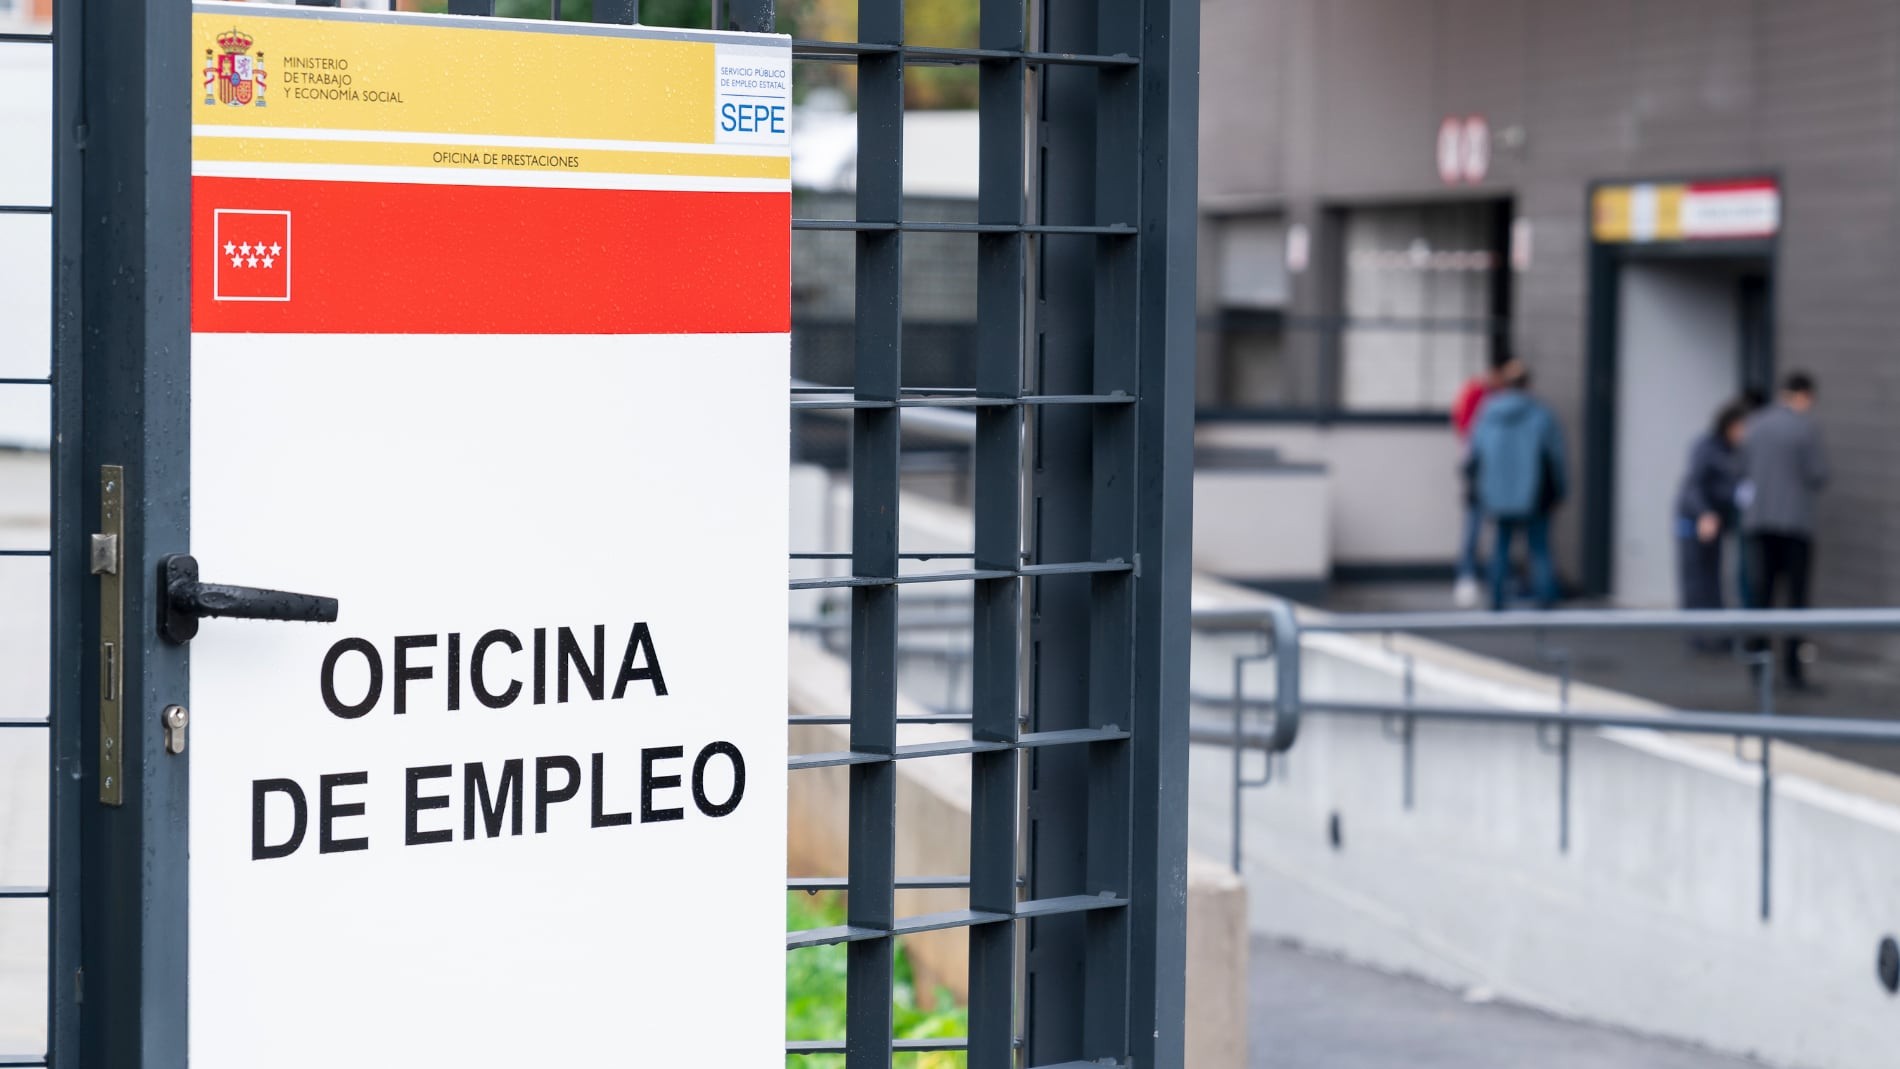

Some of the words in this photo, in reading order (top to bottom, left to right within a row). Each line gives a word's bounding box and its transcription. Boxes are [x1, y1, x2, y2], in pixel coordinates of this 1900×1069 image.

[283, 57, 348, 71] MINISTERIO
[283, 72, 299, 84] DE
[300, 73, 352, 88] TRABAJO
[721, 67, 753, 76] SERVICIO
[755, 68, 786, 78] PÚBLICO
[721, 79, 730, 87] DE
[732, 79, 758, 88] EMPLEO
[760, 81, 786, 89] ESTATAL
[283, 88, 291, 99] Y
[294, 88, 360, 102] ECONOMÍA
[362, 91, 404, 104] SOCIAL
[721, 103, 786, 133] SEPE
[432, 151, 480, 165] OFICINA
[483, 153, 498, 165] DE
[501, 154, 580, 168] PRESTACIONES
[320, 621, 669, 719] OFICINA
[252, 770, 369, 861] DE
[405, 740, 746, 847] EMPLEO
